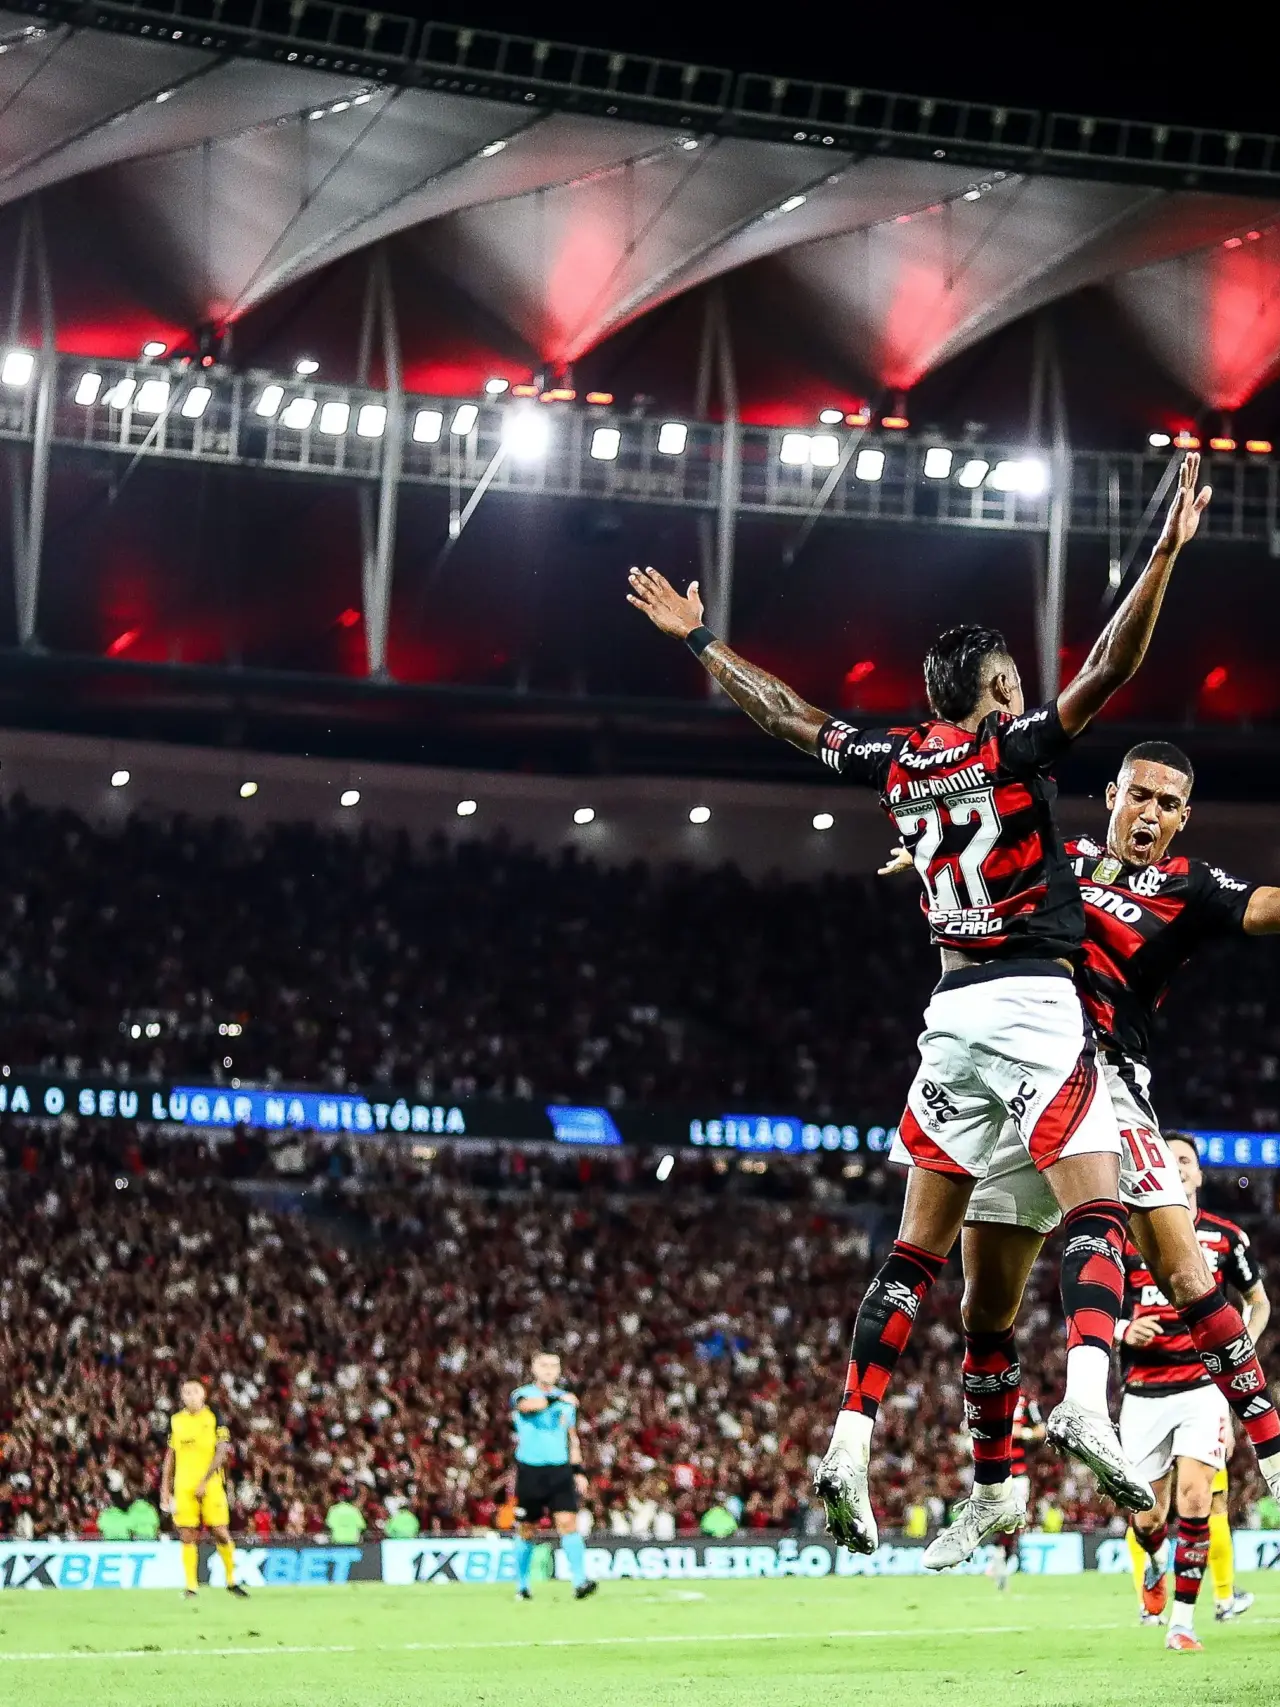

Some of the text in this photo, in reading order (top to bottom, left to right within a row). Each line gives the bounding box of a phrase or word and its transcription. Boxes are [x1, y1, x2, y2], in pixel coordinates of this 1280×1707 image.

[906, 803, 933, 815] TEXACO
[959, 796, 987, 805] TEXACO
[890, 786, 1003, 911] 27
[1079, 886, 1142, 923] ano
[944, 917, 1003, 935] CARD
[44, 1086, 65, 1115] O
[79, 1088, 138, 1118] SEU
[152, 1092, 252, 1125] LUGAR
[265, 1097, 305, 1126] NA
[318, 1098, 466, 1134] HISTÓRIA
[922, 1080, 959, 1124] abc
[689, 1116, 793, 1149] LEILÃO
[801, 1123, 859, 1151] DOS
[1120, 1128, 1166, 1171] 16
[1234, 1137, 1251, 1164] E
[1225, 1334, 1254, 1360] Zé
[2, 1552, 155, 1588] 1XBET
[413, 1550, 519, 1582] 1XBE
